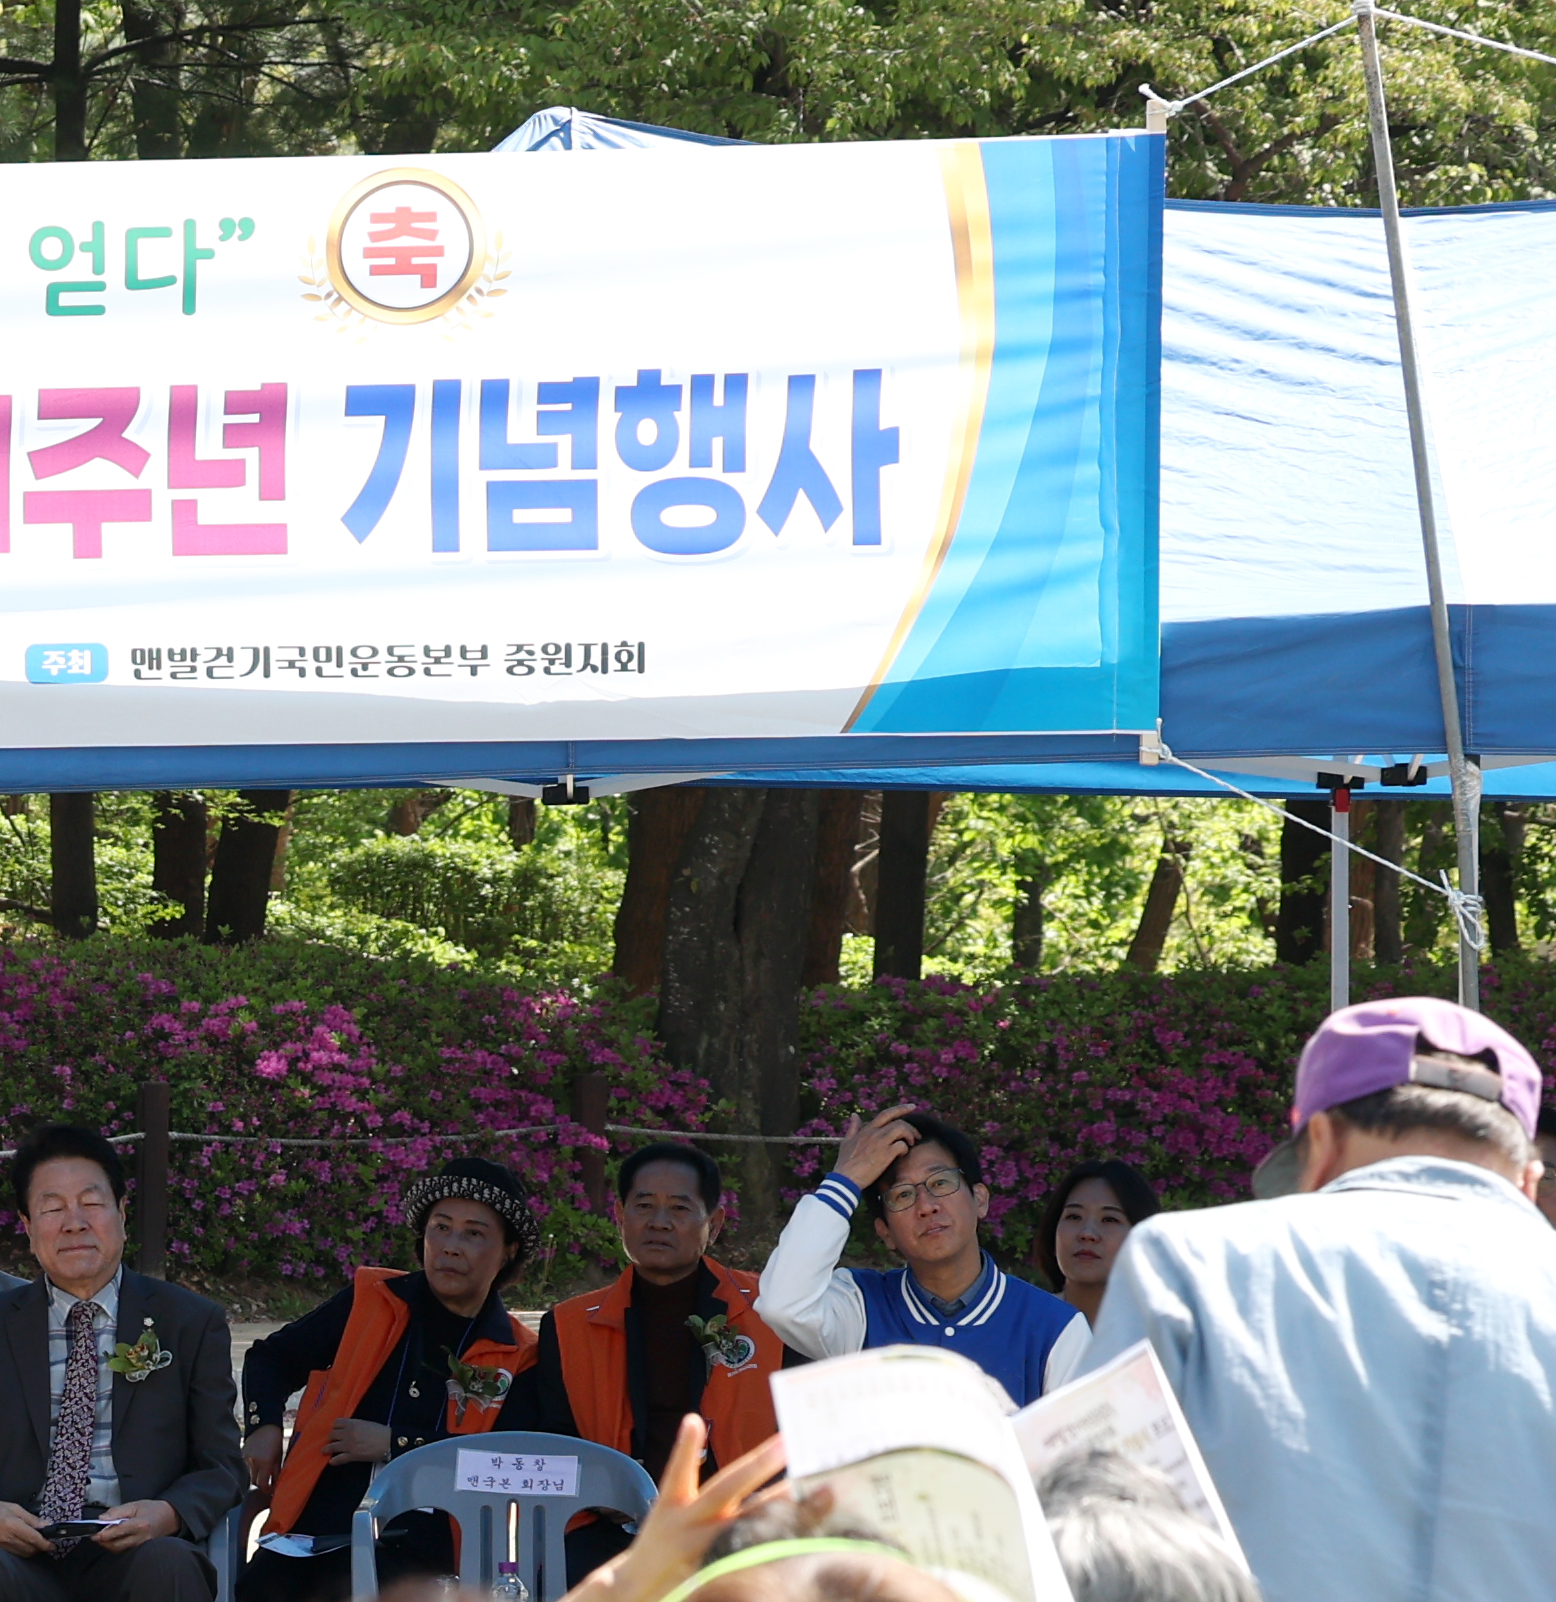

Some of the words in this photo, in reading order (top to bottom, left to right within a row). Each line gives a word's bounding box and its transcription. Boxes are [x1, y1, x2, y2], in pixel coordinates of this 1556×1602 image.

[29, 217, 256, 318] 얻다”
[363, 205, 445, 290] 축
[341, 367, 900, 556] 기념행사
[41, 648, 92, 676] 주최
[130, 644, 491, 680] 맨발걷기국민운동본부
[503, 640, 646, 676] 중원지회
